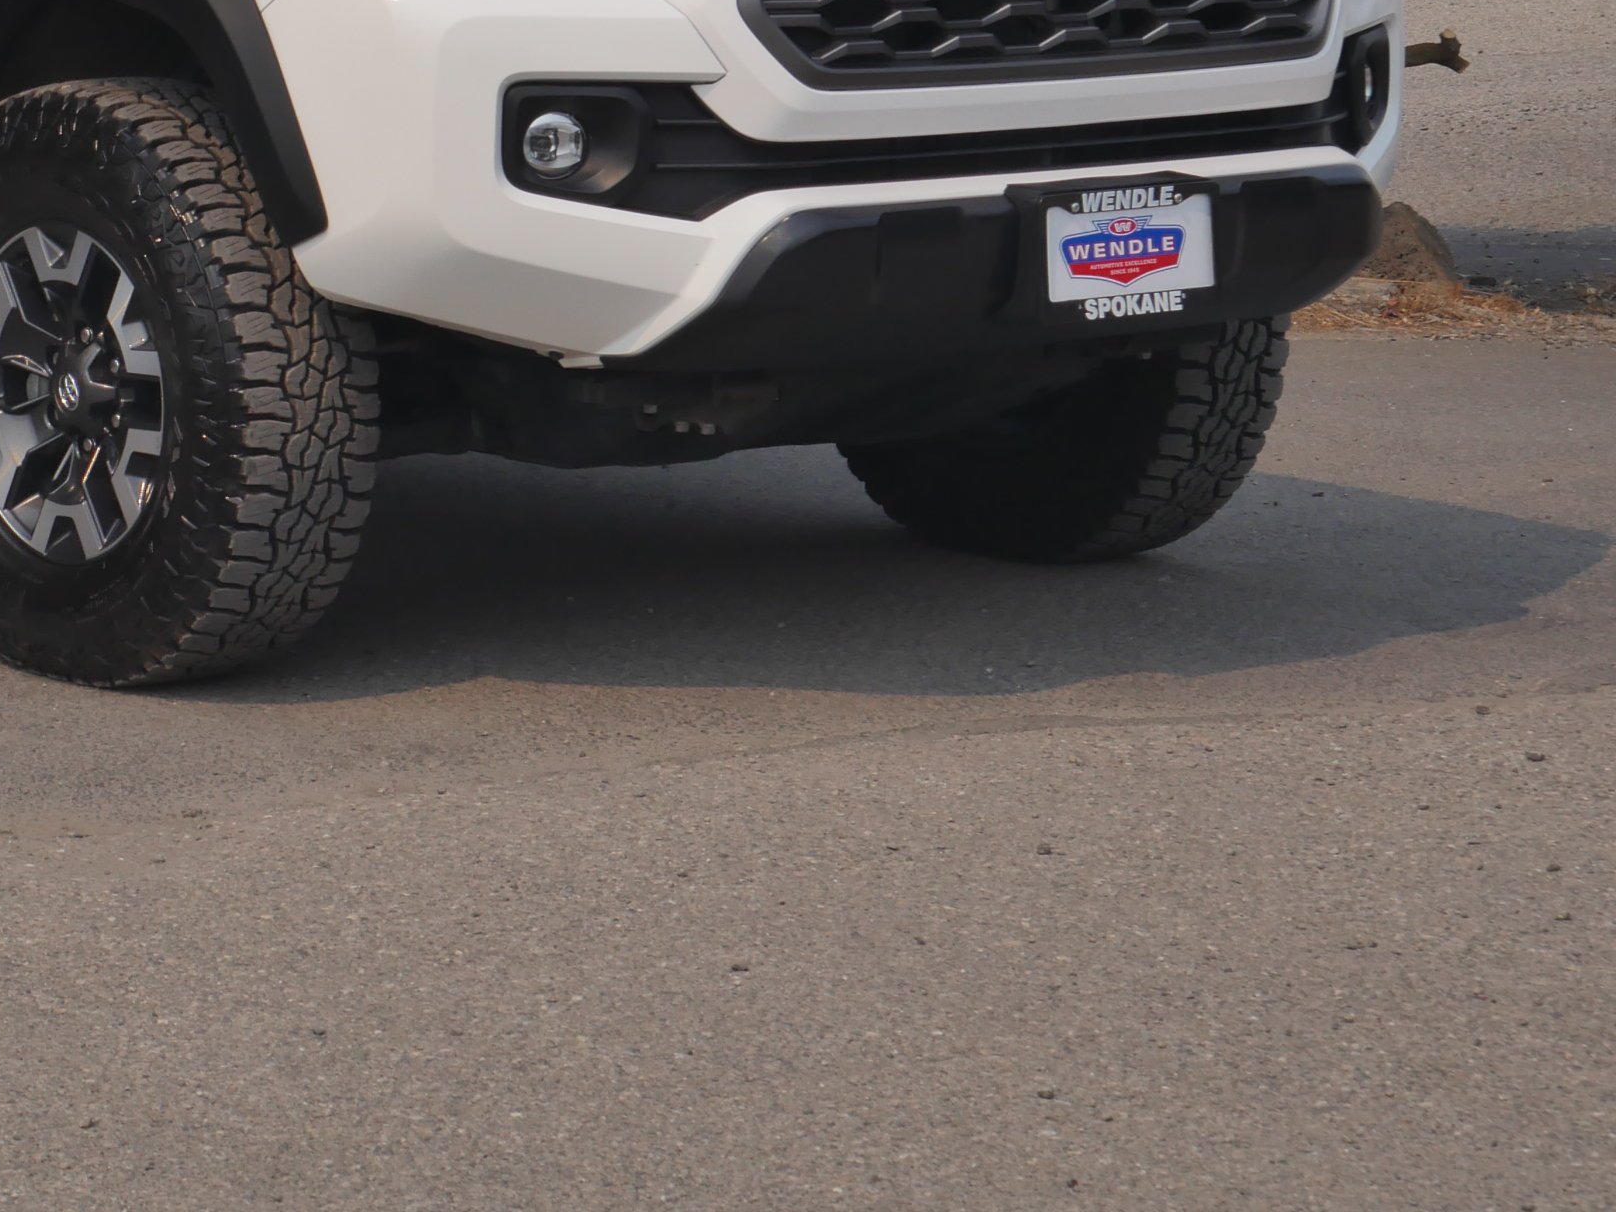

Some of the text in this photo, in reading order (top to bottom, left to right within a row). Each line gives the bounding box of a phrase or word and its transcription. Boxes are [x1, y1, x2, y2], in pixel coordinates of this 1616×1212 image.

[1082, 185, 1175, 213] WENDLE
[1068, 236, 1175, 261] WENDLE
[1090, 258, 1157, 270] AUTOMOTIVE EXCELLENCE
[1085, 290, 1184, 320] SPOKANE
